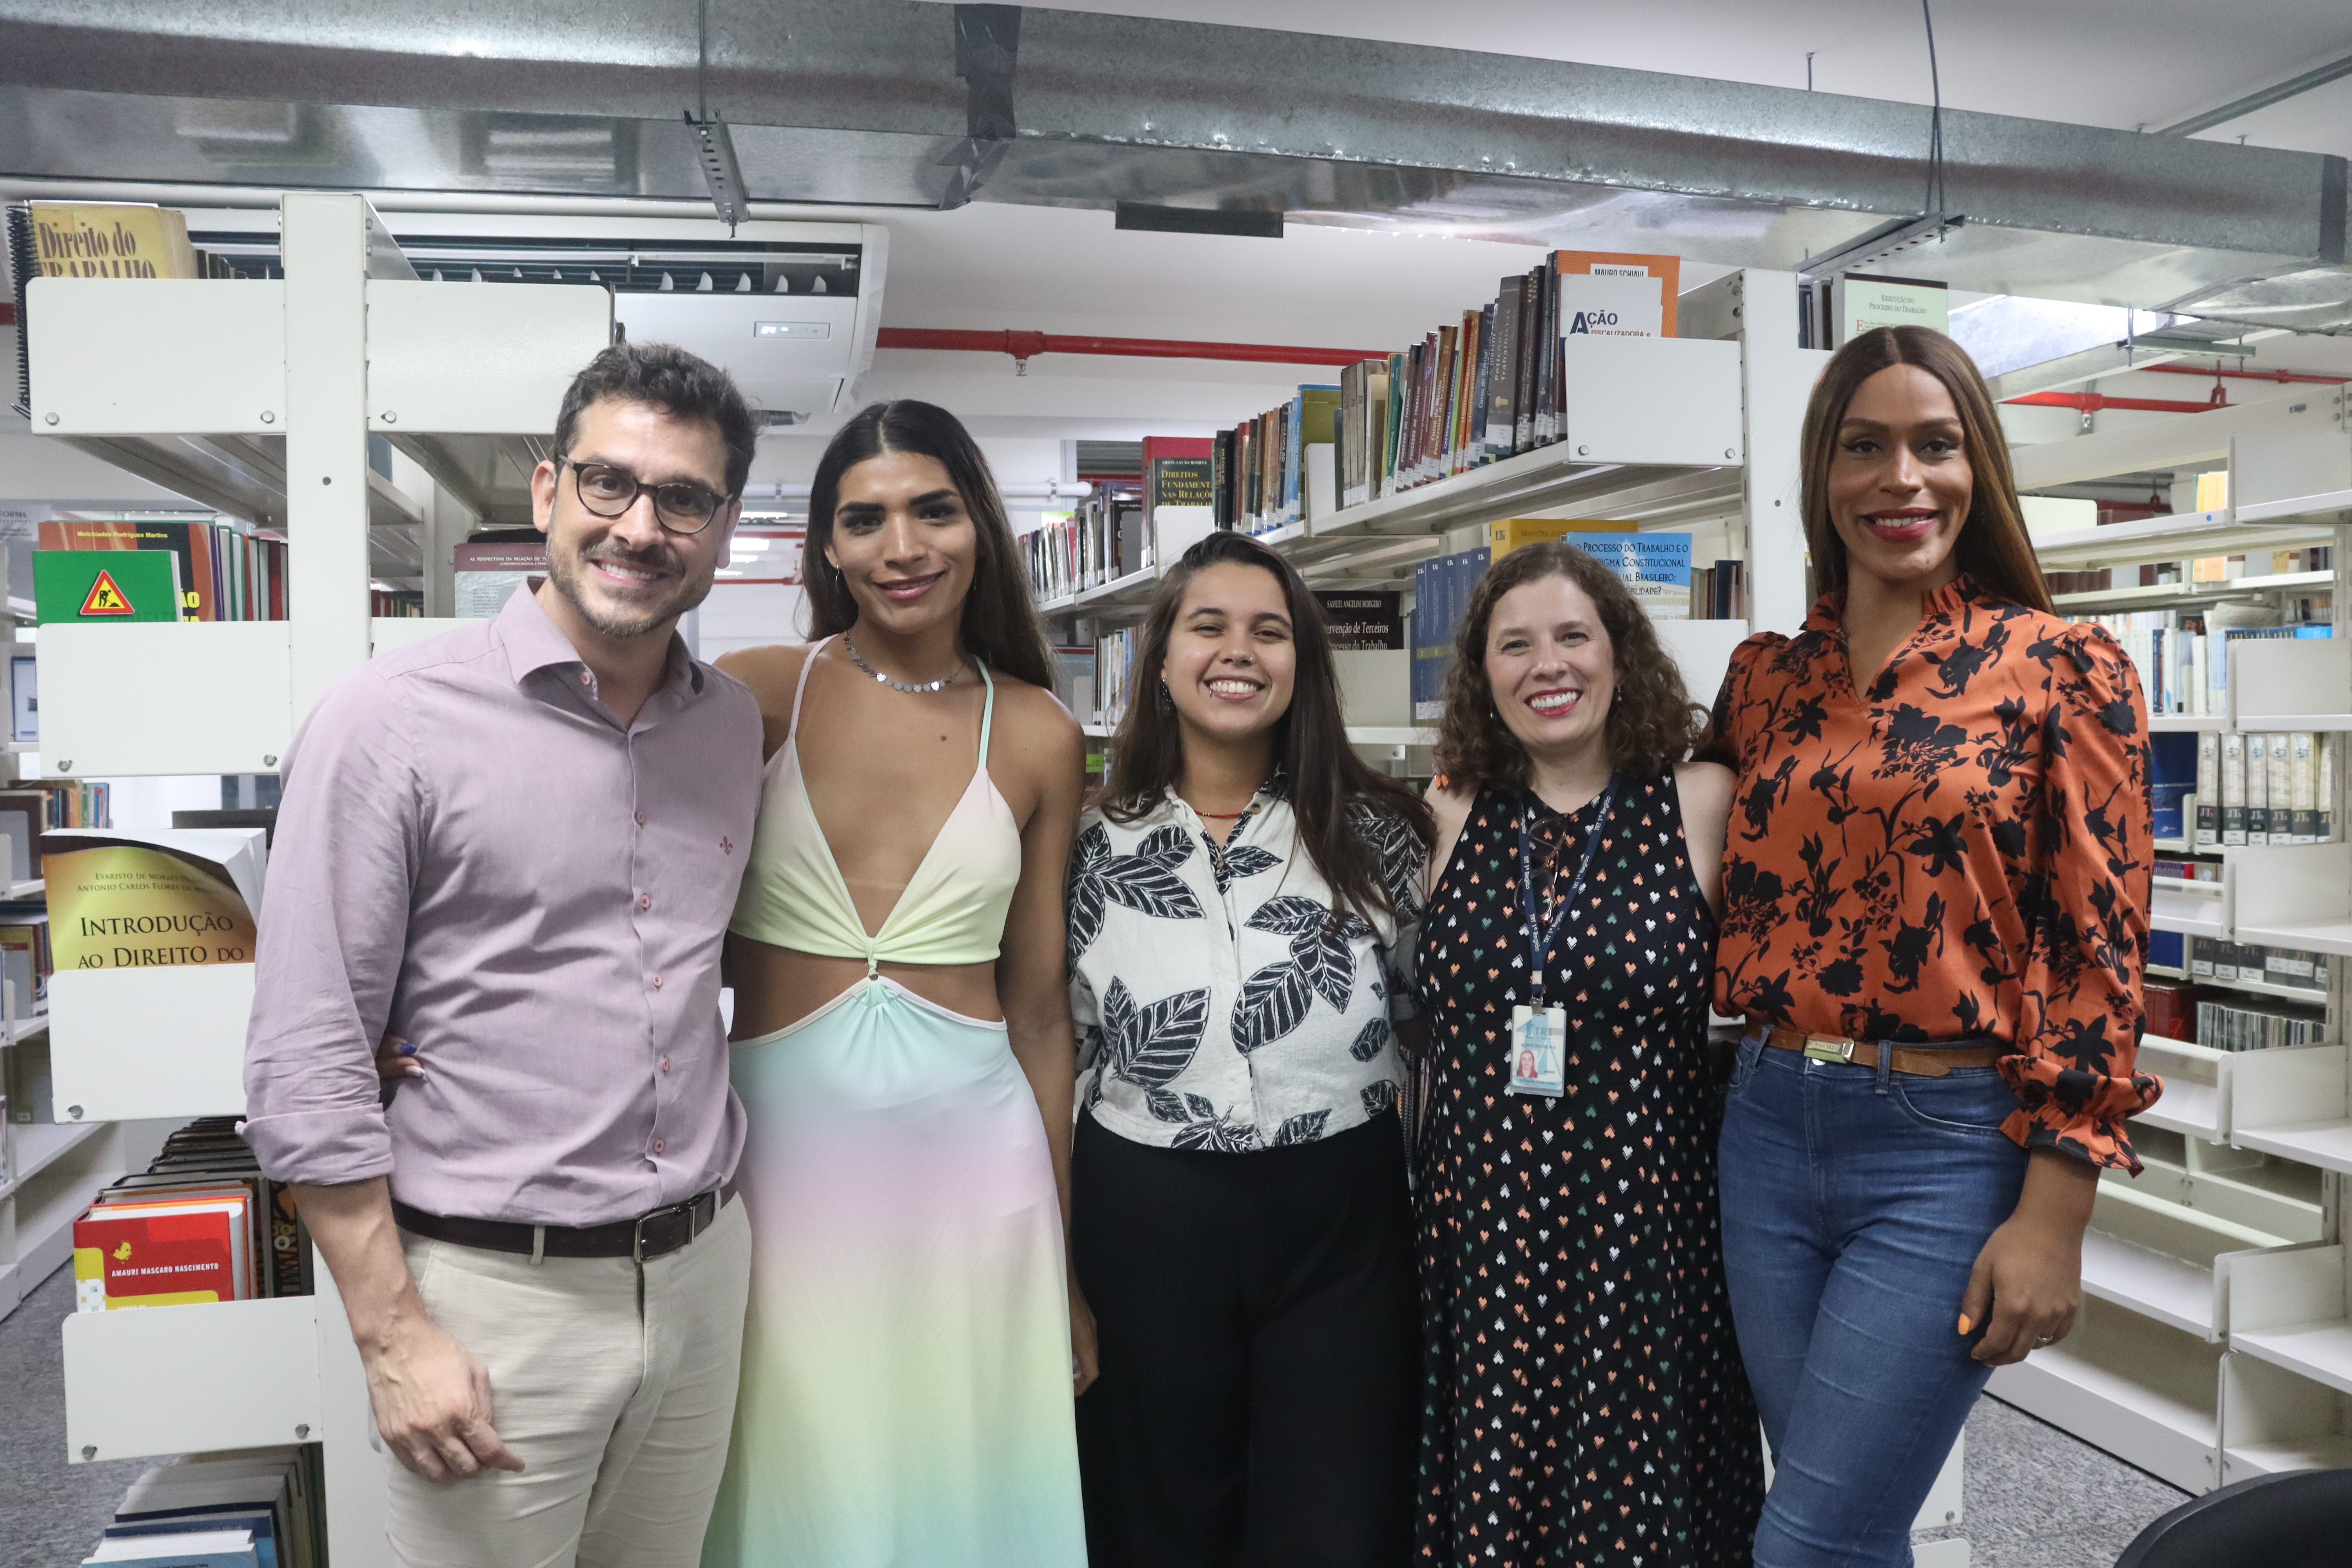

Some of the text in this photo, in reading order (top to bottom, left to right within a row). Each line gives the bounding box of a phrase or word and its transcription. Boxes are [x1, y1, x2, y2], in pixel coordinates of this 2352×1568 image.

[38, 222, 136, 258] Direito do
[1882, 294, 1907, 303] EXECUÇÃO
[1869, 303, 1893, 311] PROCESSO
[1902, 305, 1927, 314] TRABALHO
[1570, 310, 1618, 334] AÇÃO
[1404, 421, 1408, 430] DO
[1413, 419, 1417, 427] DO
[1281, 453, 1285, 462] DO
[1161, 470, 1198, 479] DIREITOS
[1584, 542, 1622, 552] PROCESSO
[1637, 543, 1674, 552] TRABALHO
[1622, 557, 1686, 567] CONSTITUCIONAL
[1636, 572, 1676, 581] BRASILEIRO:
[1353, 622, 1360, 633] de
[1362, 622, 1388, 633] Terceiros
[1352, 640, 1360, 650] do
[1361, 640, 1387, 650] Trabalho
[1600, 796, 1611, 815] Região
[1579, 855, 1590, 874] Região
[80, 911, 233, 936] INTRODUÇÃO
[1551, 911, 1564, 927] Região
[78, 946, 244, 969] AO DIREITO DO
[1535, 1027, 1553, 1036] TRT
[112, 1263, 219, 1277] AMAURI MASCARO NASCIMENTO
